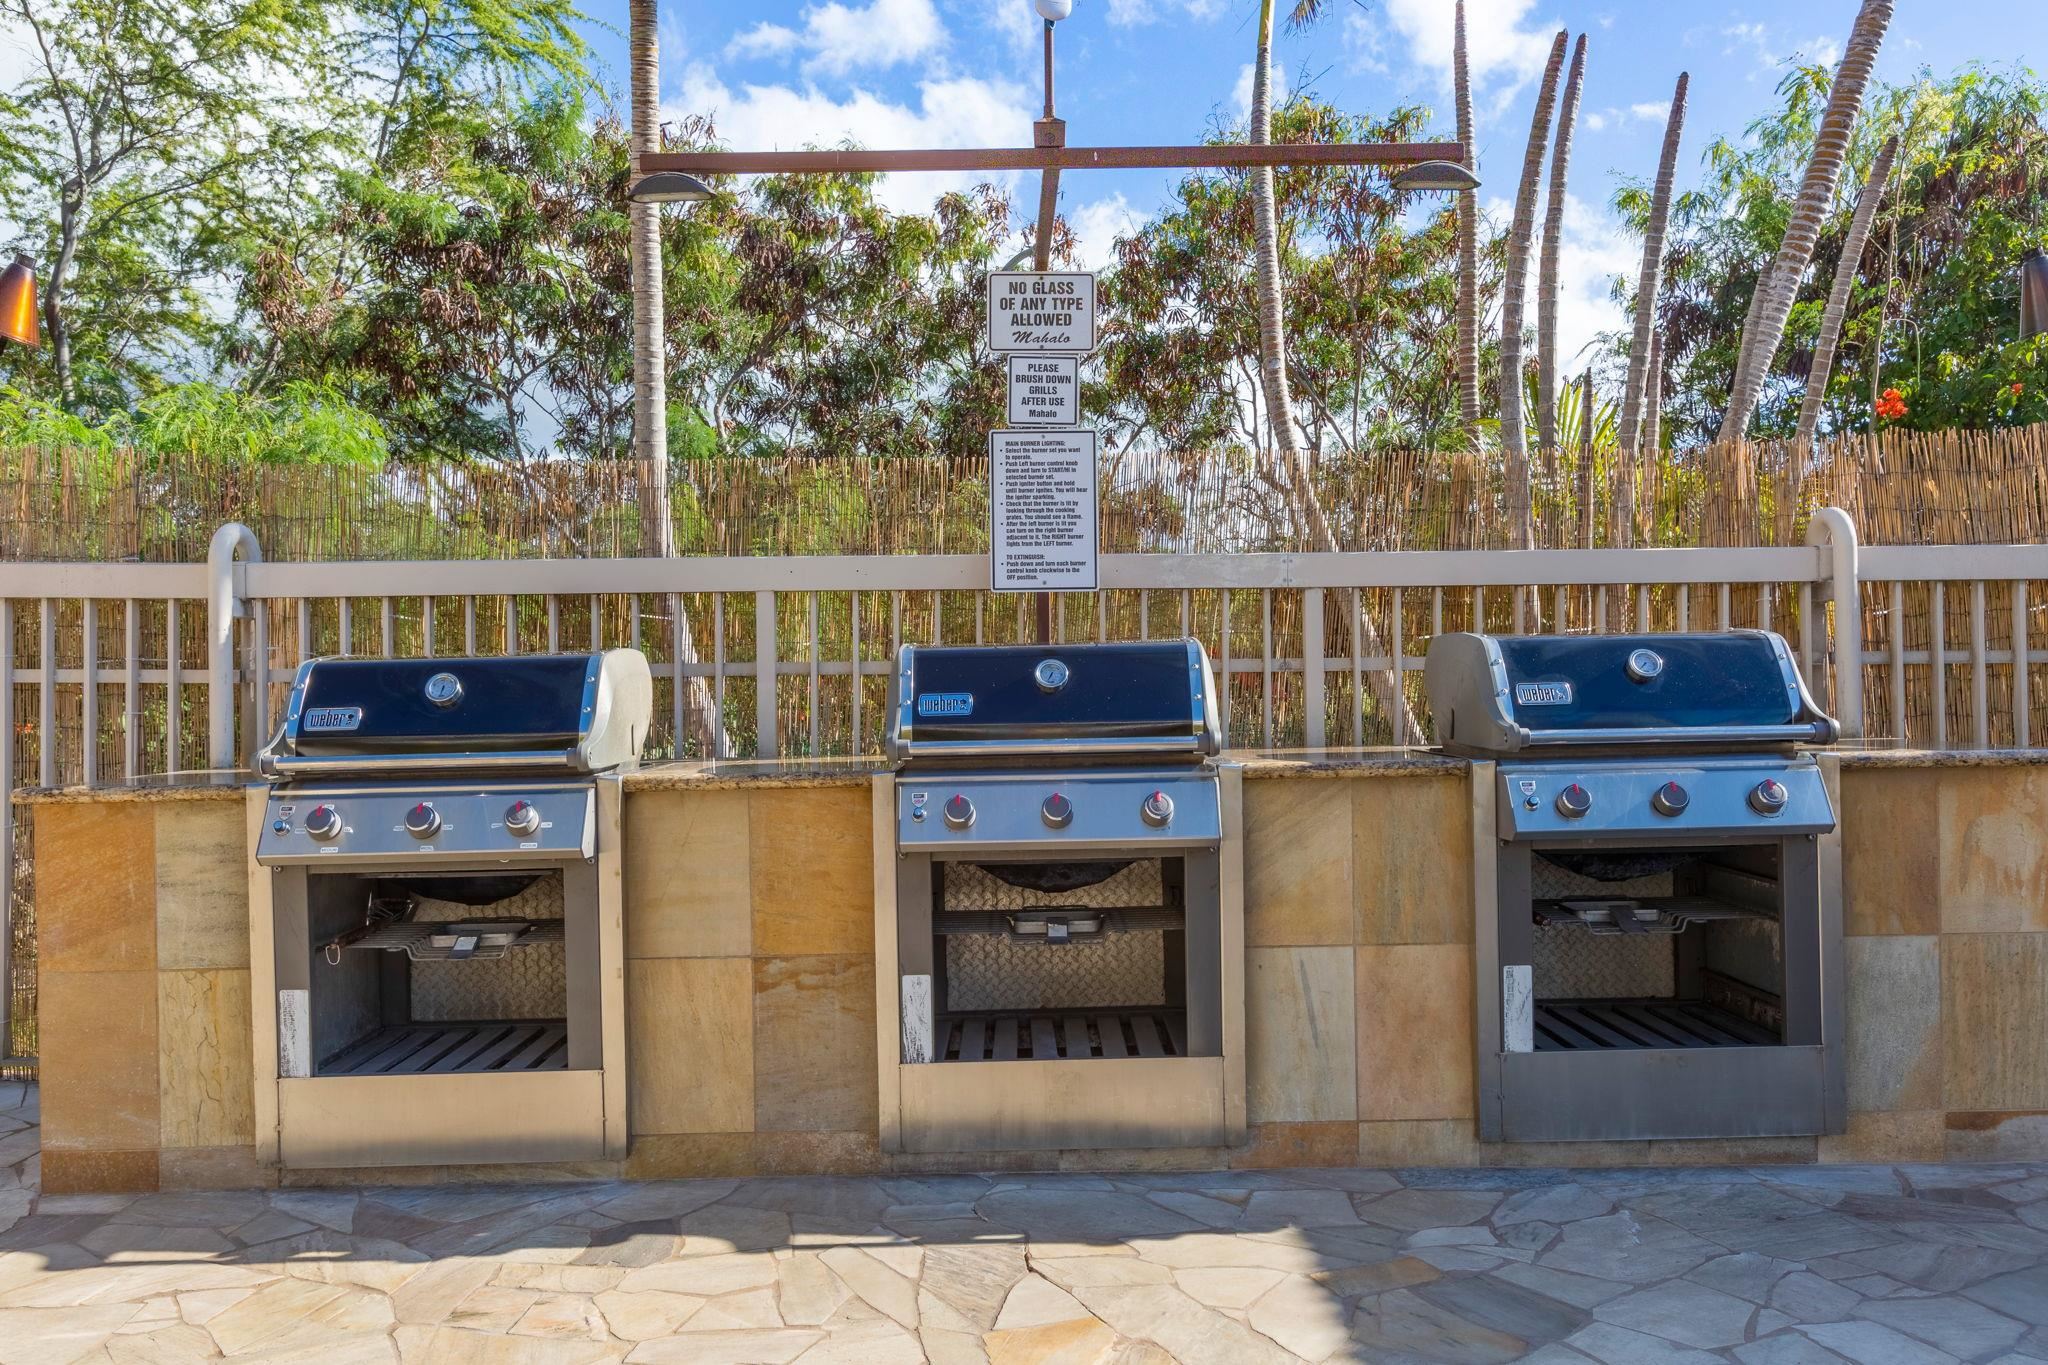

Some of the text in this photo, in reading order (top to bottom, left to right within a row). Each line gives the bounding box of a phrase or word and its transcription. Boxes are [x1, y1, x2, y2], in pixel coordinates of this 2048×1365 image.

[1009, 282, 1074, 294] NO GLASS
[1000, 298, 1083, 310] OF ANY TYPE
[1011, 314, 1072, 326] ALLOWED
[1012, 331, 1071, 343] Mahalo
[1028, 364, 1059, 372] PLEASE
[1016, 375, 1071, 383] BRUSH DOWN
[1029, 410, 1057, 418] Mahalo
[1522, 685, 1555, 701] weber
[924, 695, 957, 712] weber
[311, 710, 345, 726] weber
